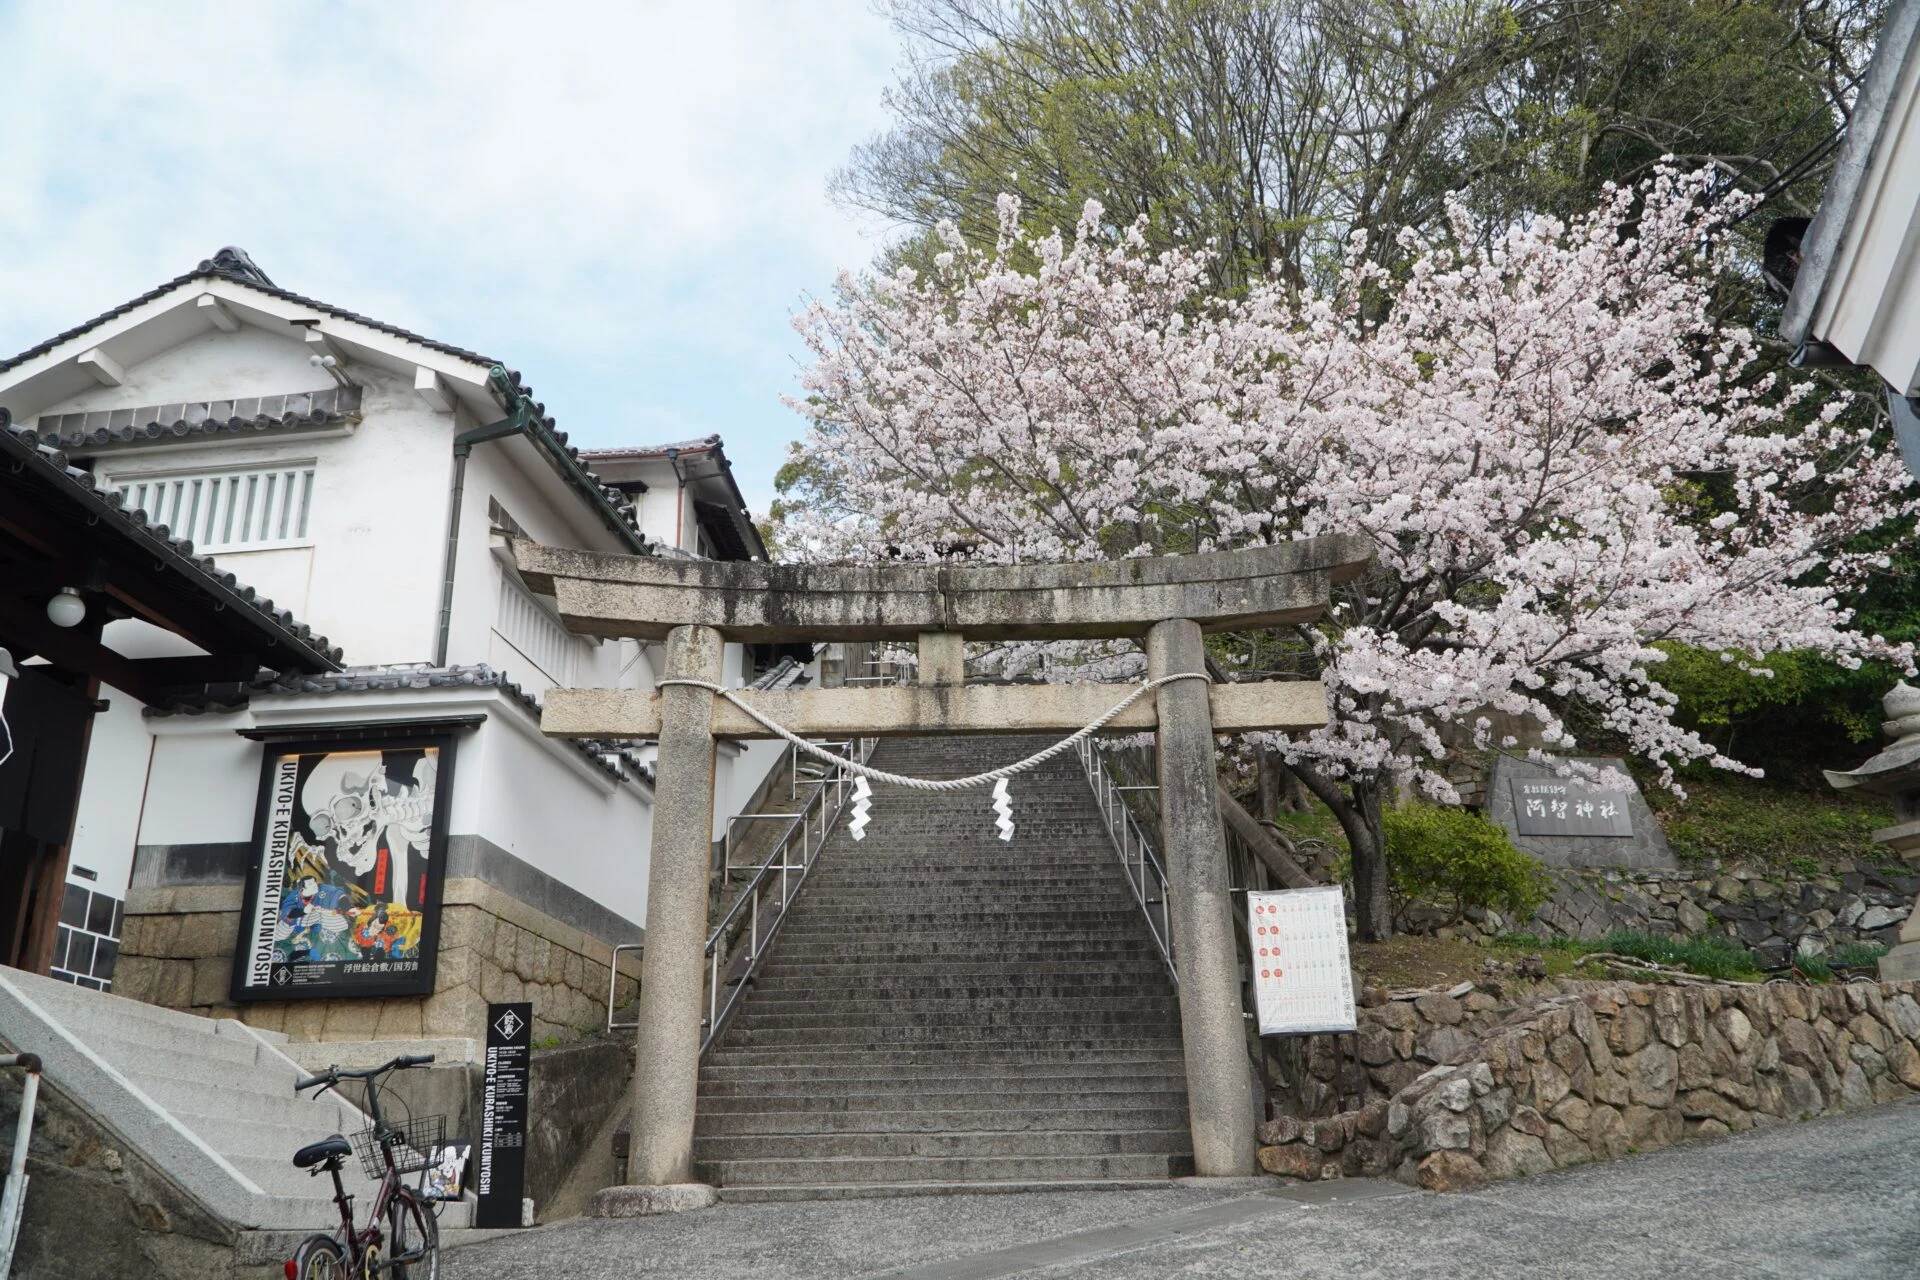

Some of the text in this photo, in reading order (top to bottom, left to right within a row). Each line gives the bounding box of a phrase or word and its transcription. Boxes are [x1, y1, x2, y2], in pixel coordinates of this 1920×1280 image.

[275, 762, 297, 816] UKIYO-E
[1526, 799, 1620, 820] 阿智神社
[264, 820, 289, 898] KURASHIKI
[485, 1046, 498, 1083] UKIYO-E
